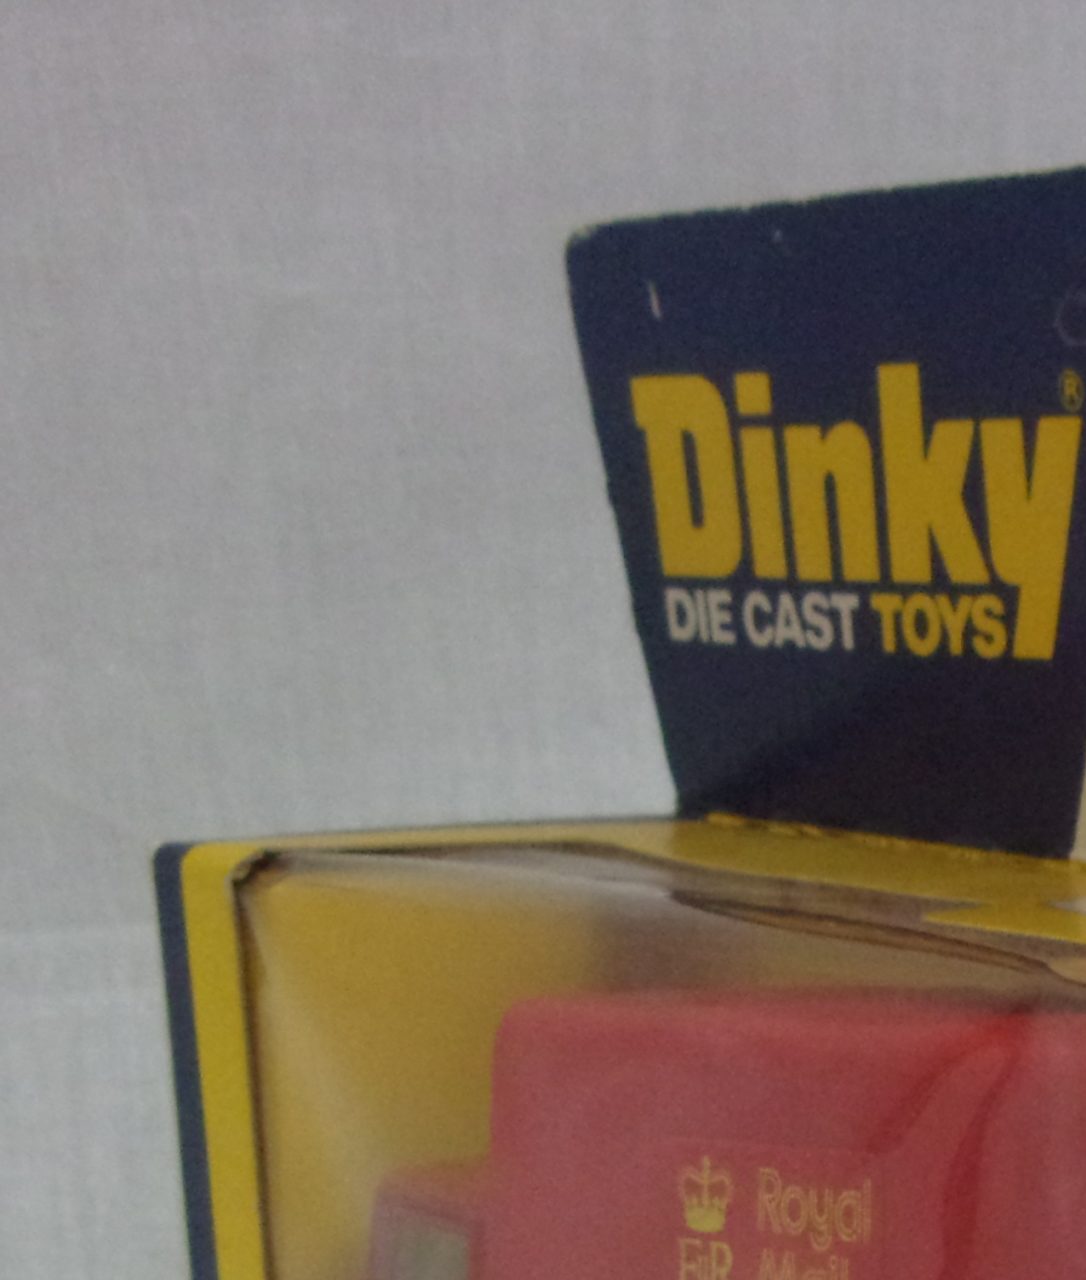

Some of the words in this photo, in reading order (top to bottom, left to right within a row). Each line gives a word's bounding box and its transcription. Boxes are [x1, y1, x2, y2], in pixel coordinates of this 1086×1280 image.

[629, 361, 1083, 660] Dinky
[664, 589, 737, 650] DIE
[743, 592, 859, 656] CAST
[870, 594, 1008, 660] TOYS
[756, 1166, 872, 1252] Royal
